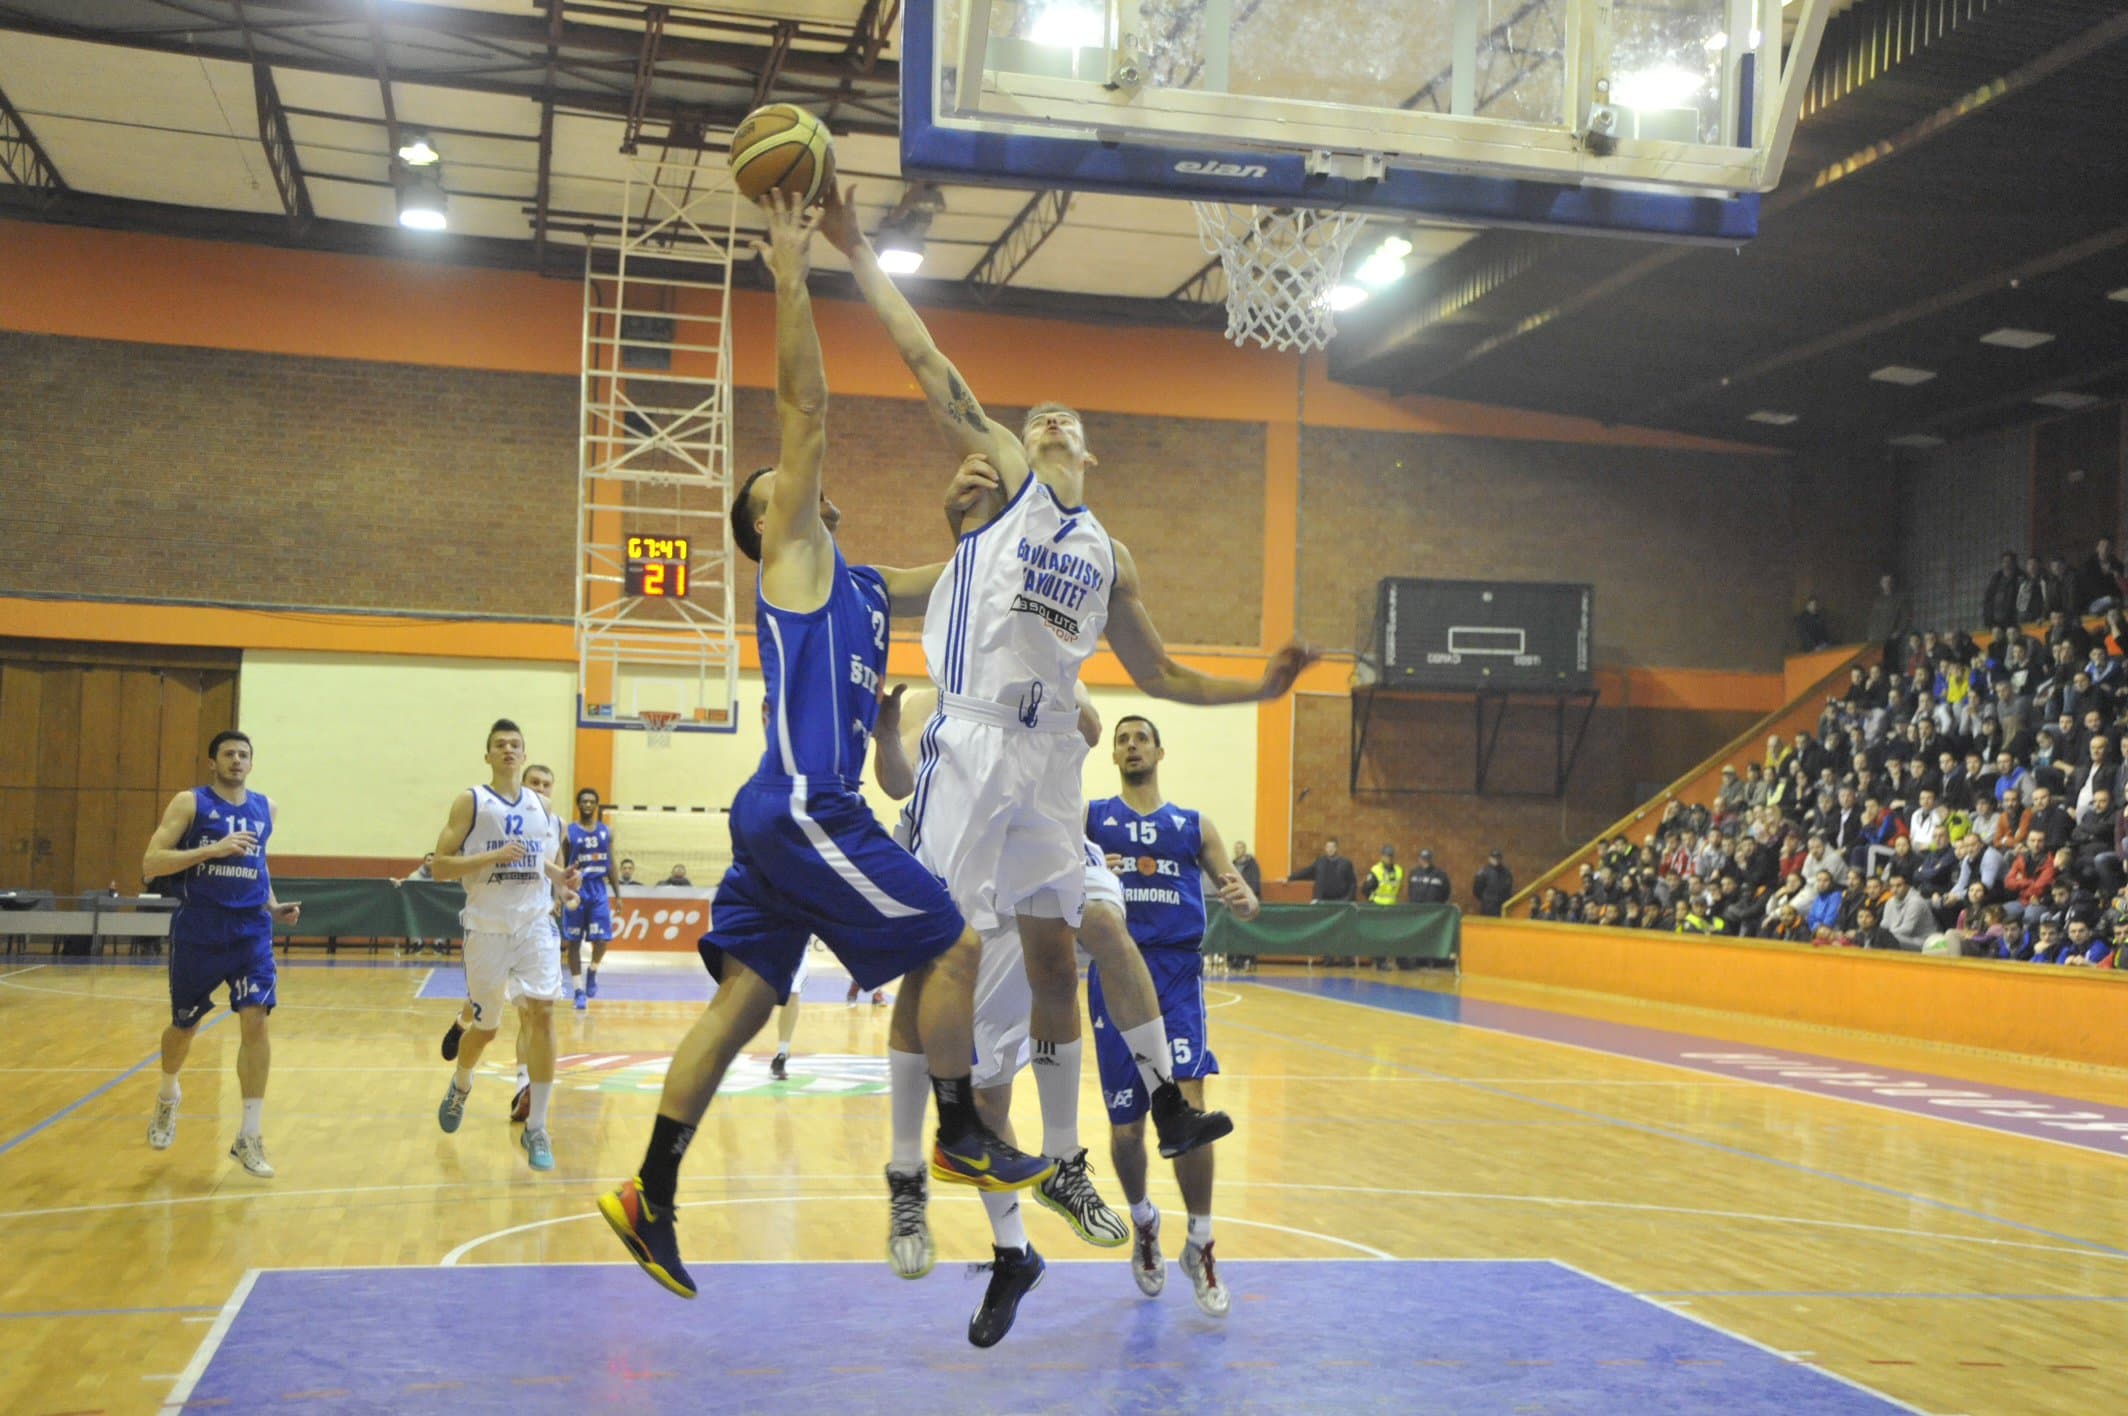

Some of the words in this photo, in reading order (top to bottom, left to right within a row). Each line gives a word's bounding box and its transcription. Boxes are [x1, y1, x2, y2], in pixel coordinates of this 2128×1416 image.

[1173, 160, 1268, 178] elan
[643, 563, 687, 597] 21
[504, 814, 524, 836] 12
[1125, 820, 1157, 845] 15
[208, 864, 258, 880] PRIMORKA
[1122, 887, 1180, 906] RIMORKA
